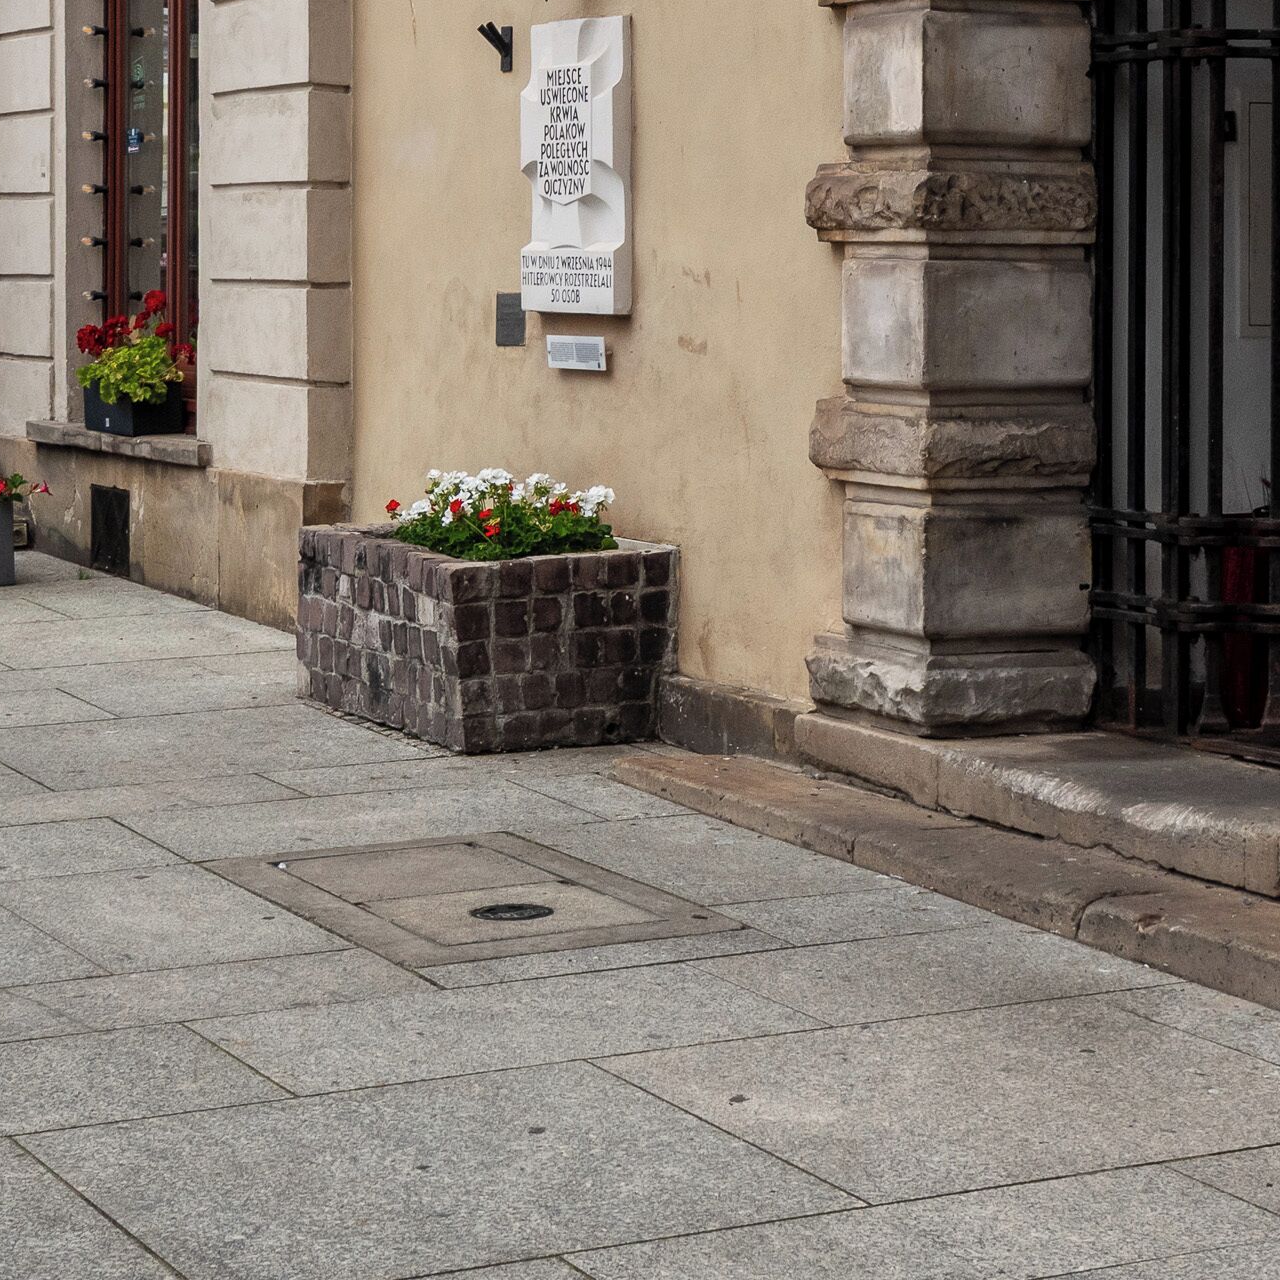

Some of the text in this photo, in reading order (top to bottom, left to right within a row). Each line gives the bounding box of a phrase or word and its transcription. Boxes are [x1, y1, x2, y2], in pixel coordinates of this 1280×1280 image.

[546, 67, 582, 87] MIEJSCE
[540, 140, 588, 160] POLEGŁYCH
[539, 161, 549, 178] ZA
[543, 177, 586, 197] OJCZYZNY
[522, 255, 530, 269] TU
[531, 255, 538, 268] W
[539, 255, 555, 269] DNIU
[556, 255, 560, 270] 2
[595, 256, 612, 271] 1944
[522, 271, 612, 289] HITLEROWCY ROZSTRZELALI
[551, 288, 561, 303] 50
